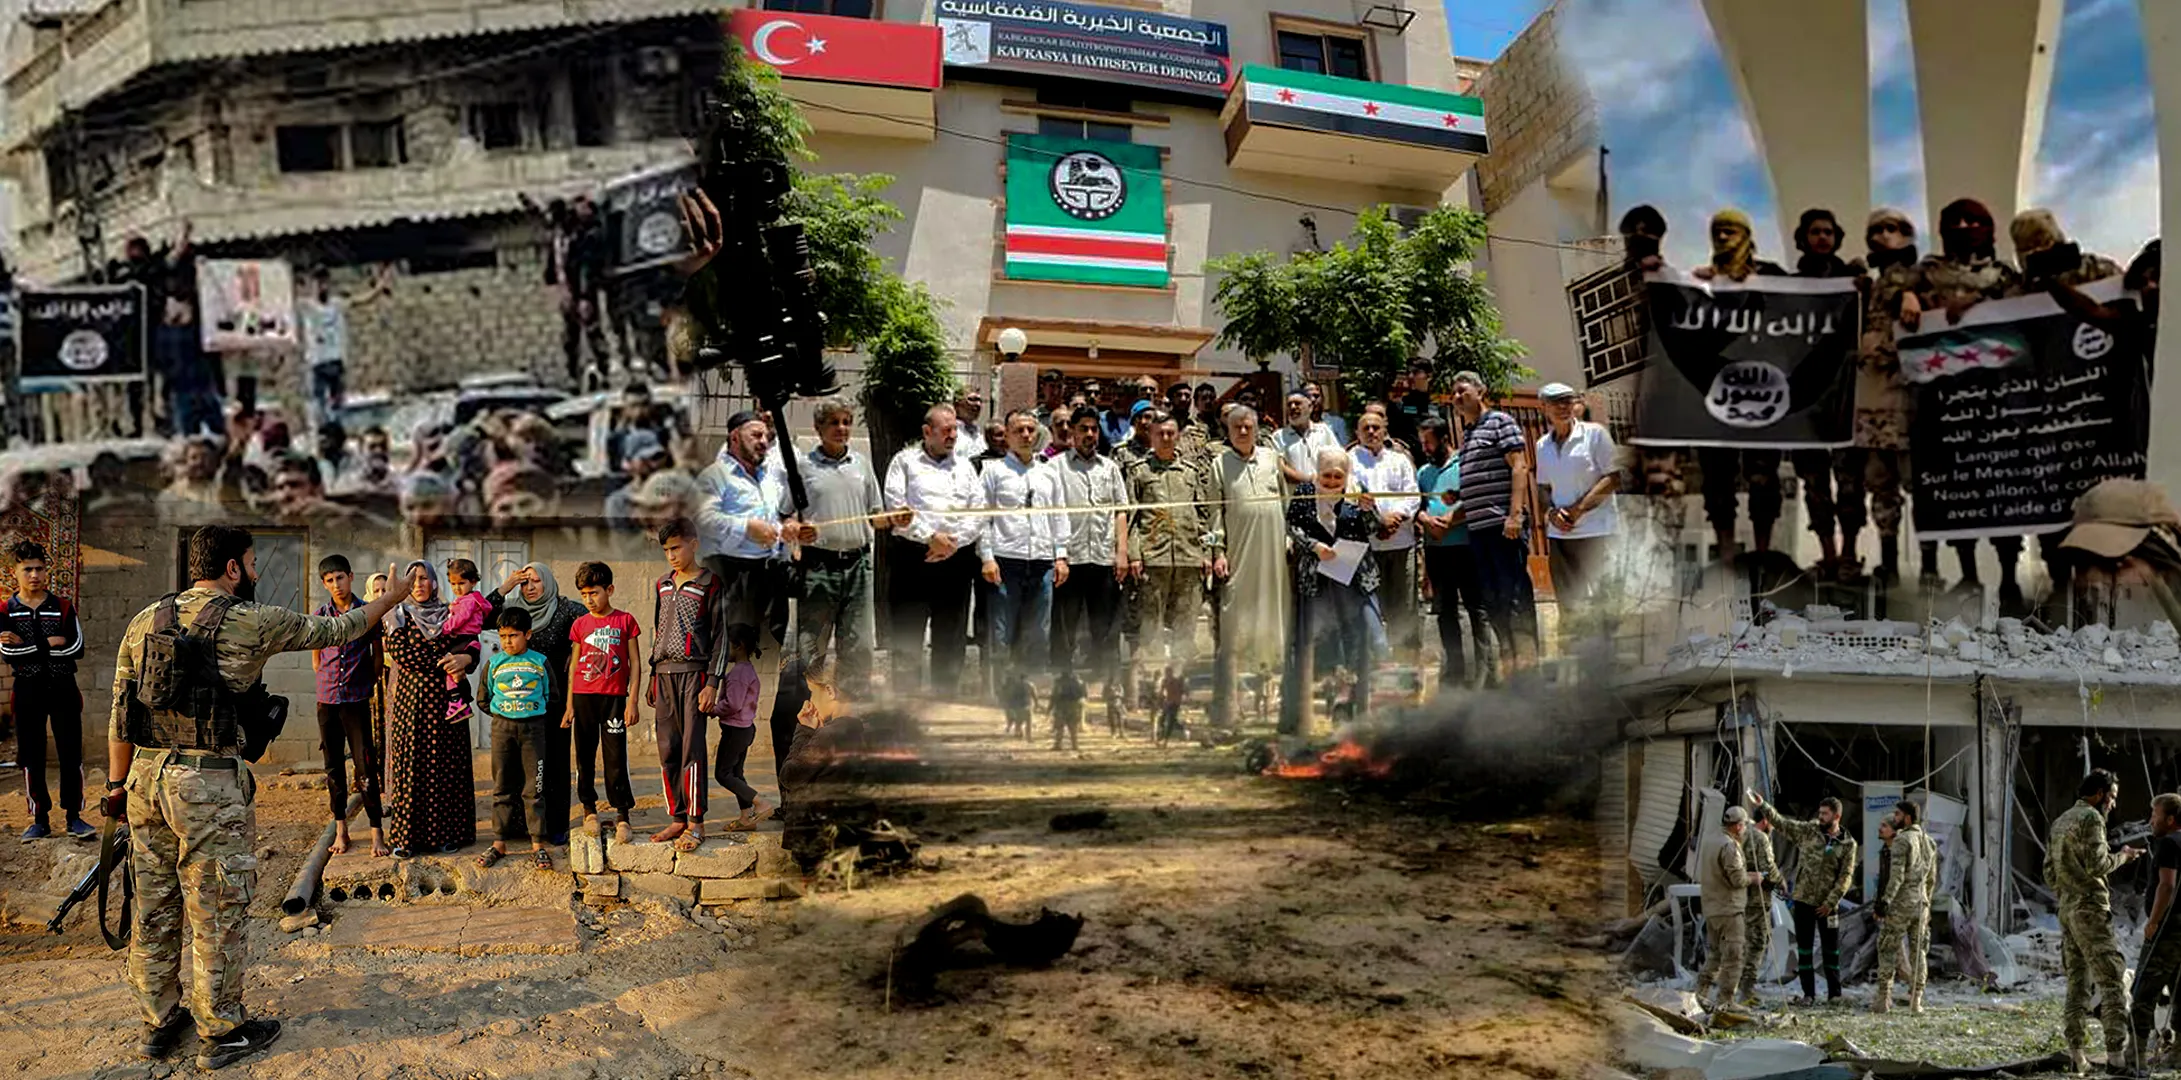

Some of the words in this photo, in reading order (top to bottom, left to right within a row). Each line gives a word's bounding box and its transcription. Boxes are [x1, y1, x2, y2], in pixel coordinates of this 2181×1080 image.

[941, 0, 1057, 23] القفقاسية
[1063, 9, 1133, 32] الخيرية
[1138, 19, 1221, 47] الجمعية
[996, 45, 1069, 63] KAFKASYA
[1072, 54, 1158, 75] HAYIRSEVER
[1722, 366, 1769, 386] الله
[2043, 365, 2108, 392] اللسان
[1713, 387, 1784, 406] رسول
[1991, 379, 2039, 399] الذي
[1985, 403, 2054, 421] رسول
[2057, 391, 2105, 413] على
[1940, 407, 1981, 422] الله
[1942, 429, 1973, 444] الله
[1977, 426, 2020, 444] بعون
[1955, 449, 2020, 465] Langue
[2026, 444, 2056, 461] qui
[2061, 440, 2096, 452] ose
[1921, 471, 1948, 486] Sur
[1953, 469, 1970, 481] le
[1975, 461, 2065, 480] Messager
[1934, 489, 1980, 501] Nous
[1985, 482, 2038, 498] allons
[2042, 479, 2059, 494] le
[1947, 507, 1988, 519] avec
[1993, 499, 2045, 517] l'aide
